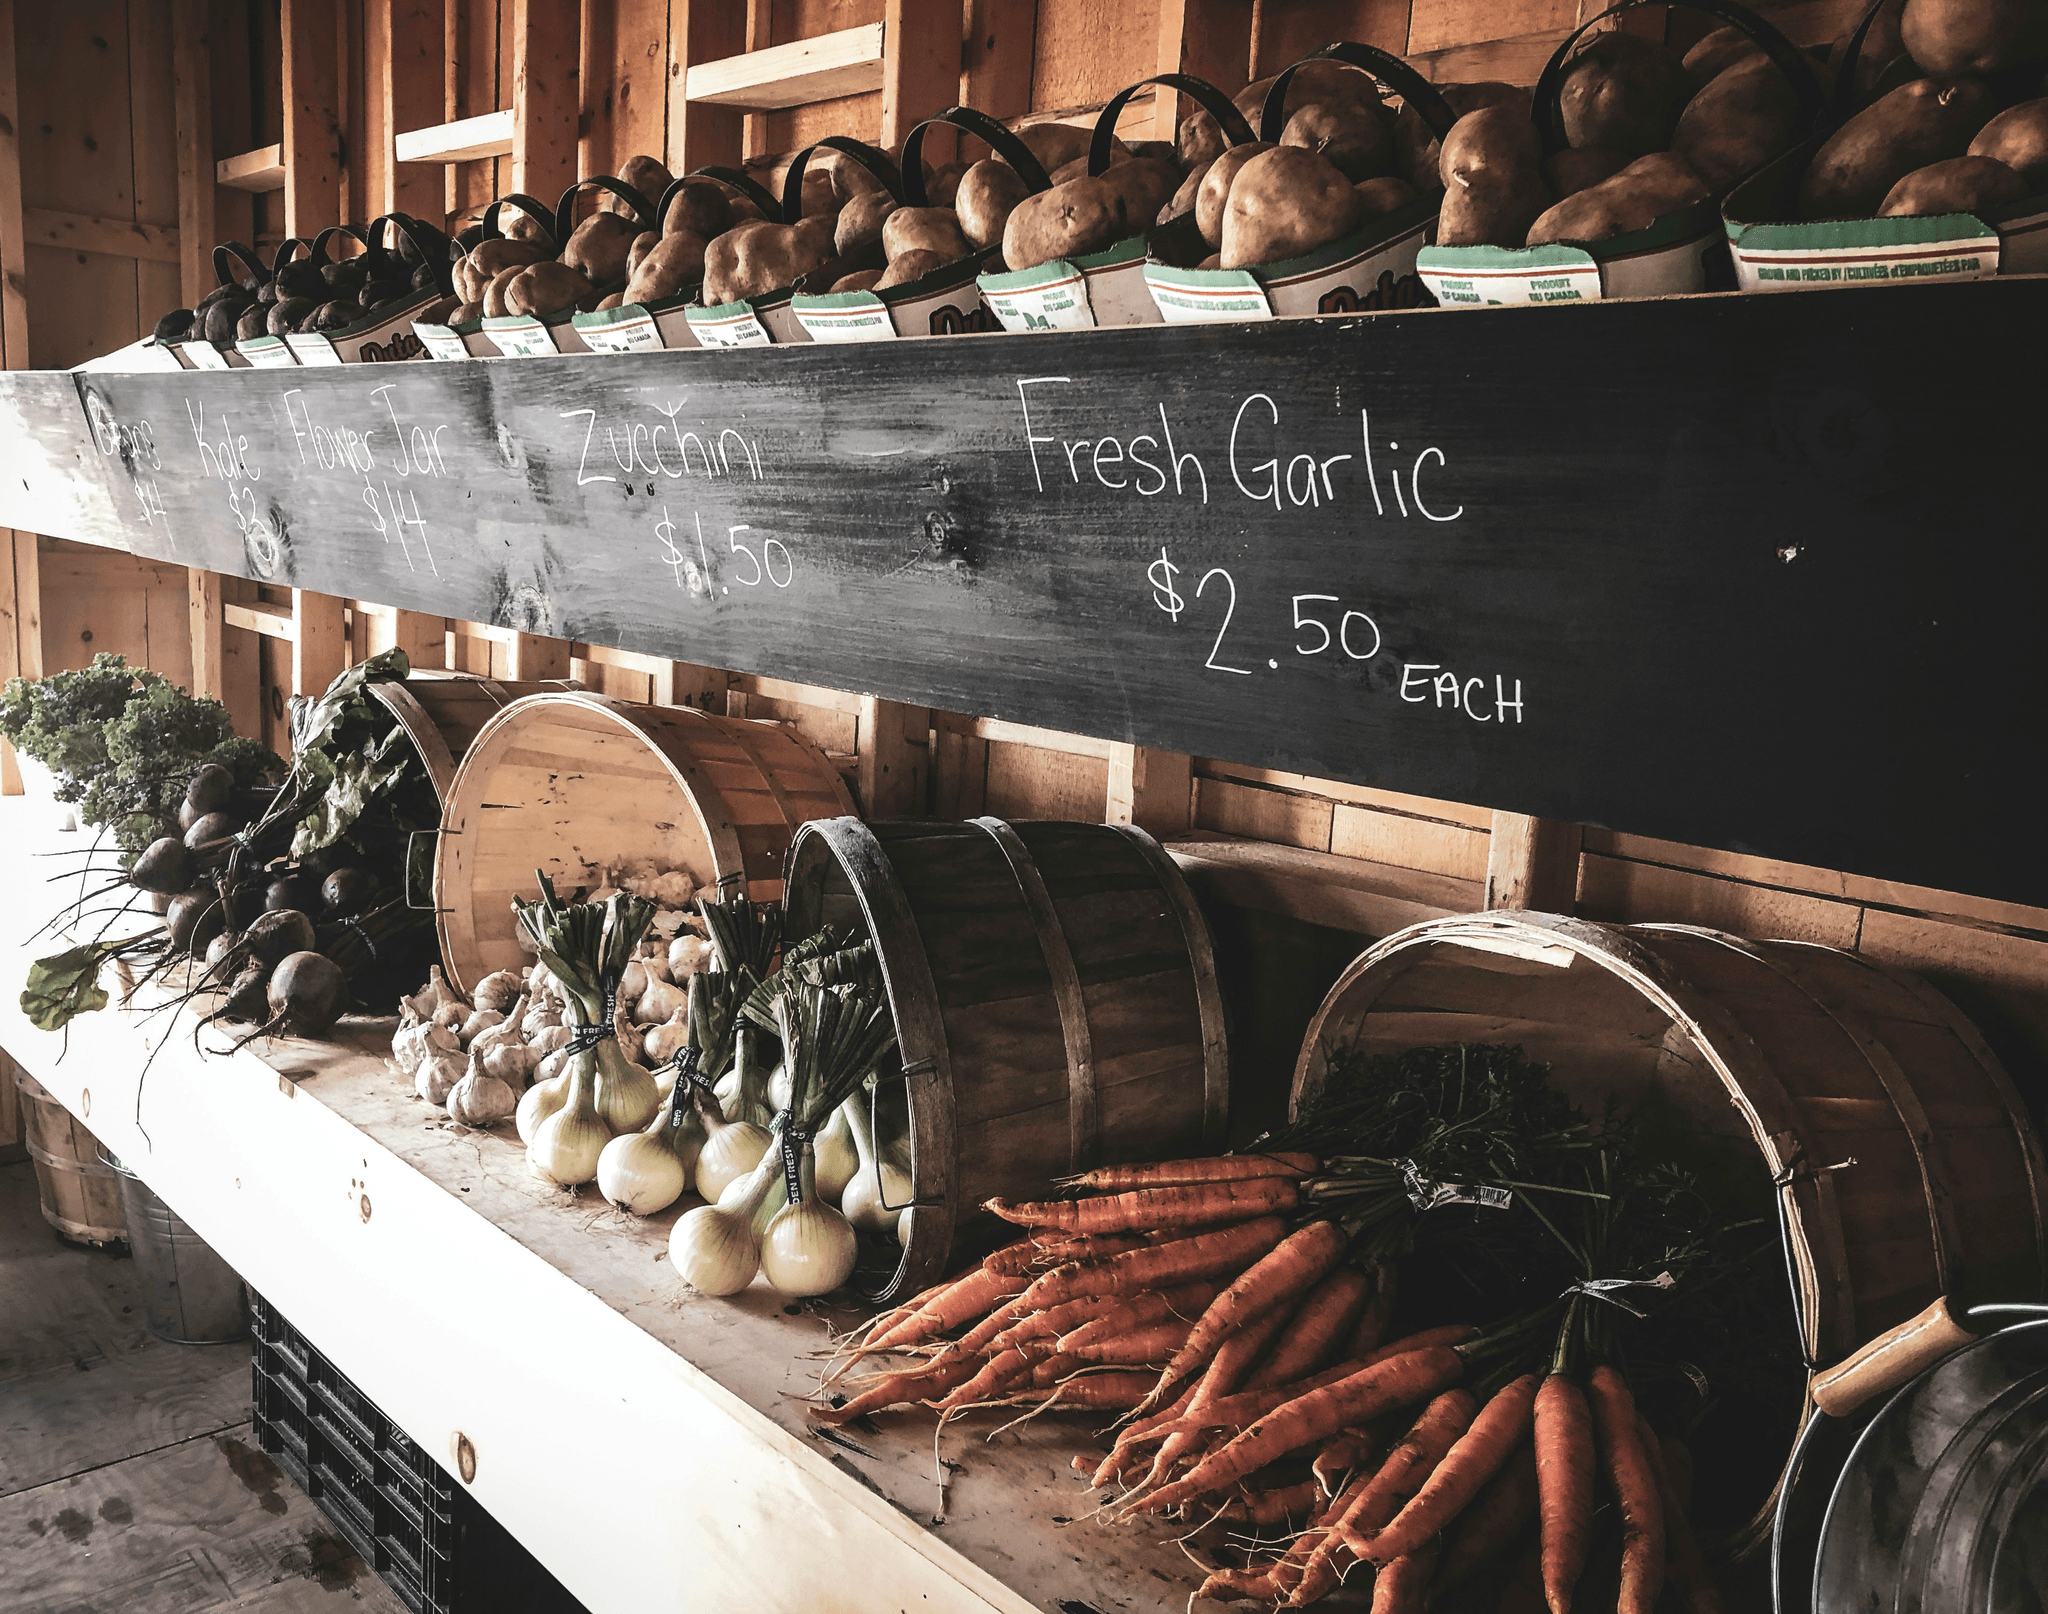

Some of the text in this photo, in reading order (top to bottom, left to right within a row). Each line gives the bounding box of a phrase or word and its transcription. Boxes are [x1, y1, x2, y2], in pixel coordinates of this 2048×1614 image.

[1530, 278, 1571, 290] PRODUIT
[1544, 290, 1583, 302] CANADA
[185, 397, 261, 481] Kale
[283, 384, 449, 478] Flower Jar
[559, 398, 763, 487] Zucchini
[1017, 376, 1463, 522] Fresh Garlic
[133, 476, 176, 550] $4
[228, 481, 273, 562] $2
[363, 474, 438, 577] $14
[654, 505, 793, 602] $1.50
[1147, 546, 1382, 675] $2.50
[1400, 664, 1524, 724] EACH
[784, 1145, 797, 1179] FRESH
